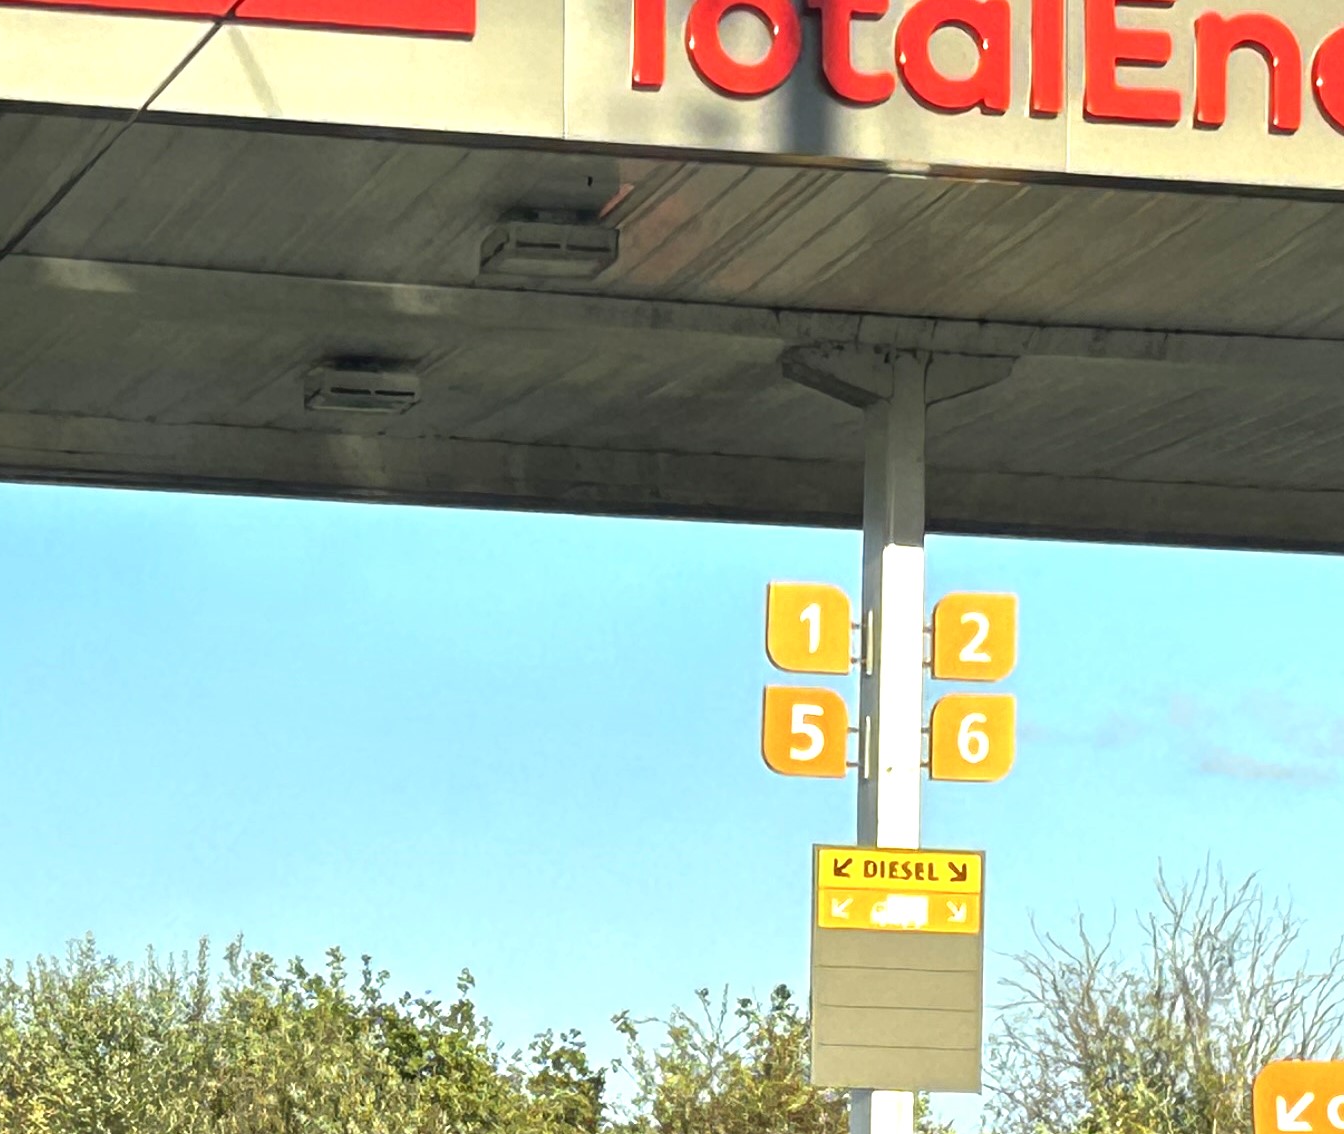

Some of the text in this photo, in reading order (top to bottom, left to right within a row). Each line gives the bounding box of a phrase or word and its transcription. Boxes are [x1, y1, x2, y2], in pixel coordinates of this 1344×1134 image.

[799, 602, 822, 653] 1
[959, 612, 992, 662] 2
[789, 704, 825, 760] 5
[957, 712, 990, 763] 6
[863, 860, 940, 881] DIESEL
